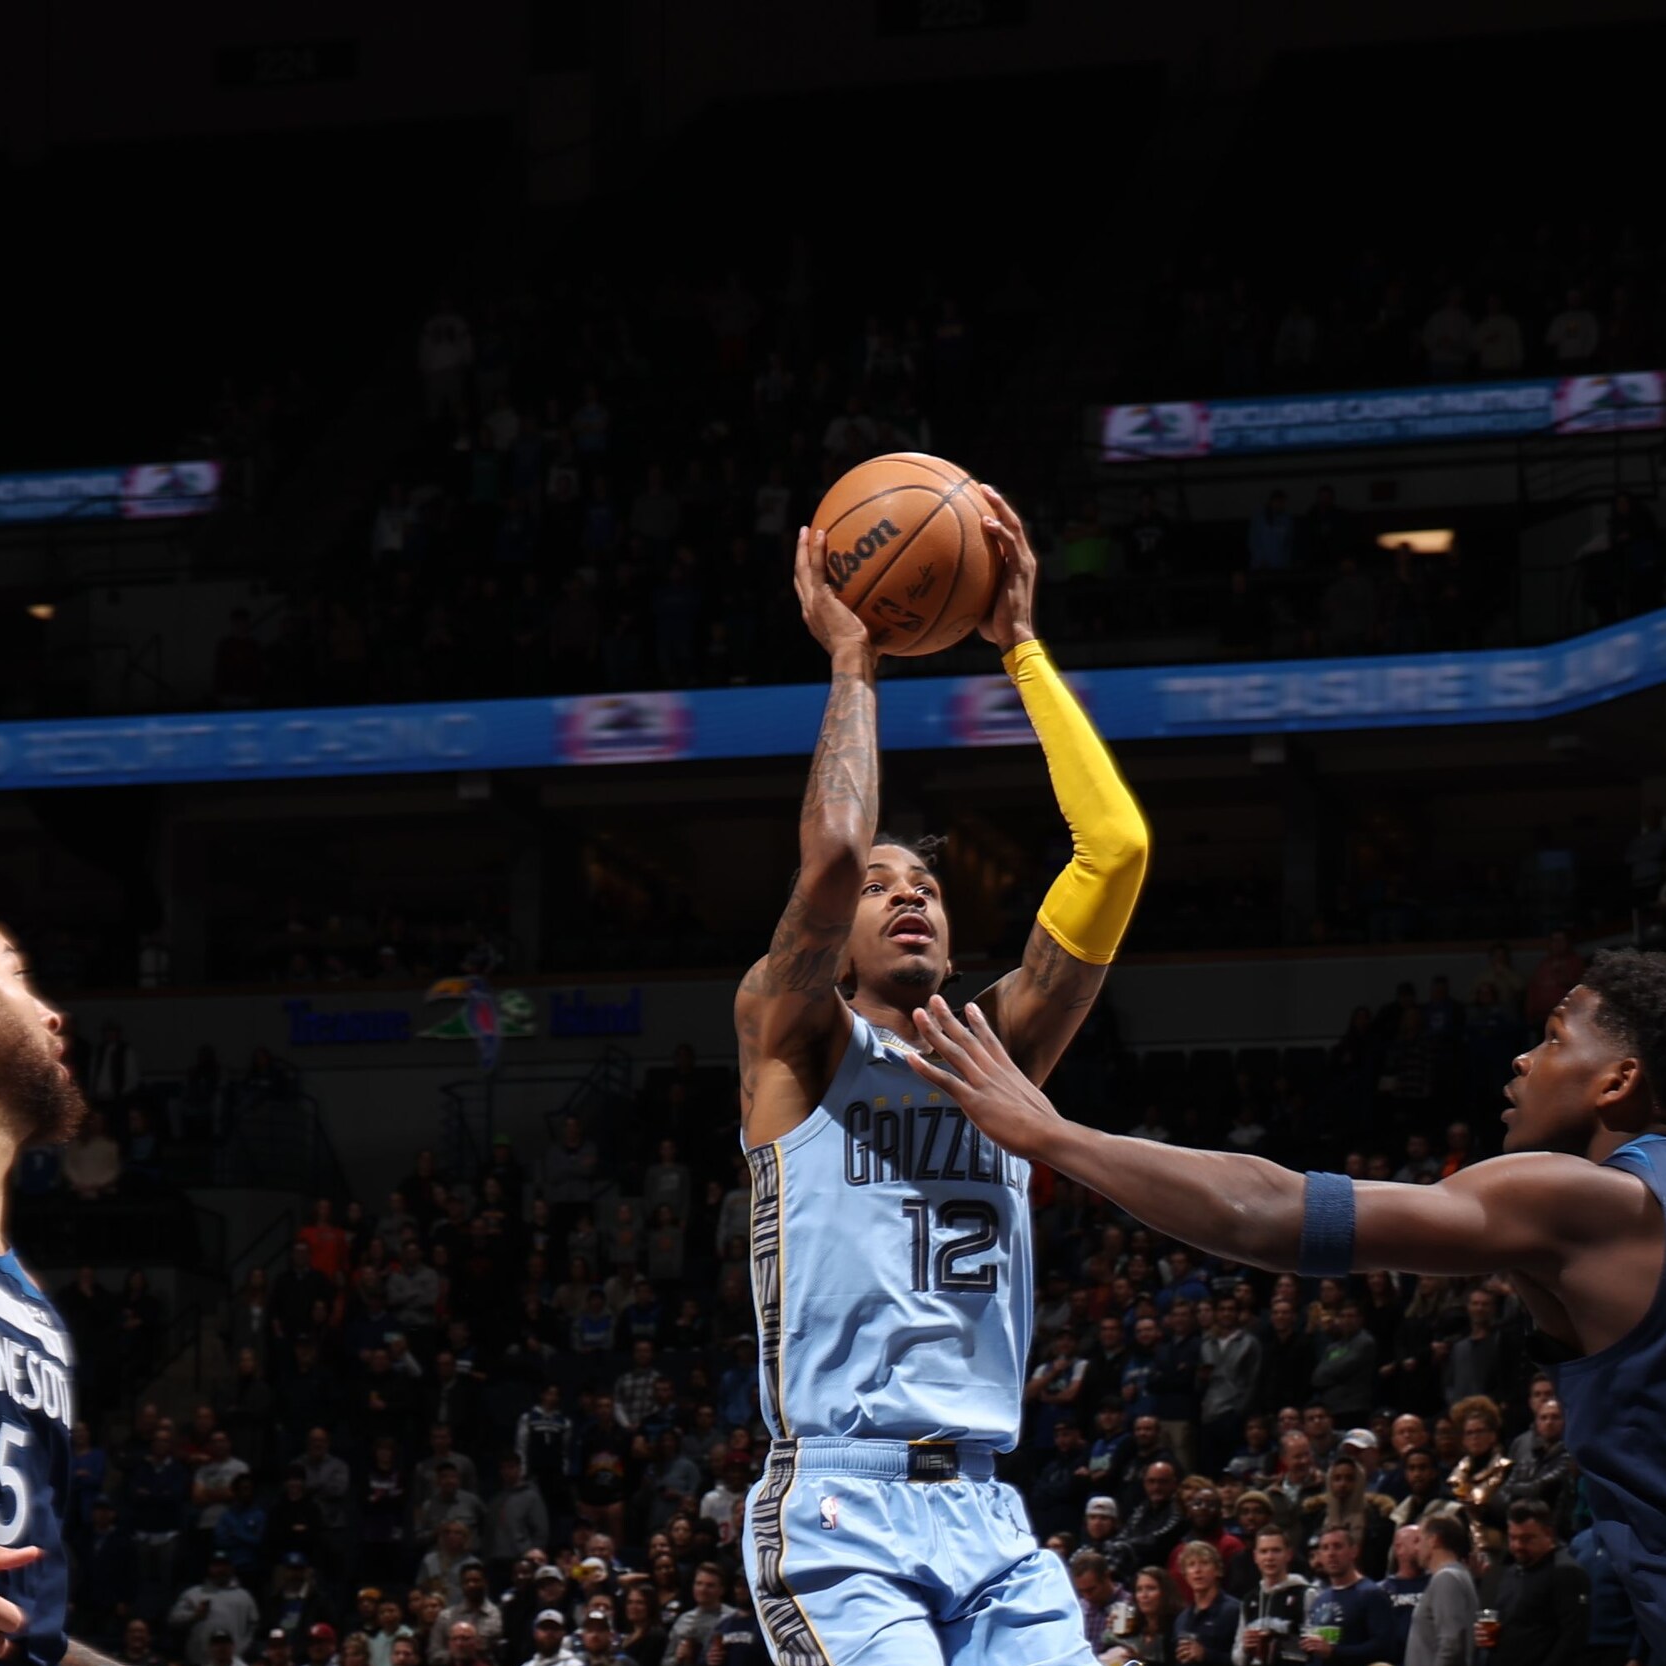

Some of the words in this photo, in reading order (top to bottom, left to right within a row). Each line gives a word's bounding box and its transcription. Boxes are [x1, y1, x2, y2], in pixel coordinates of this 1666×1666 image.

[827, 518, 901, 593] lson
[284, 998, 412, 1045] Treasure
[549, 987, 642, 1036] Island
[845, 1100, 1025, 1199] GRIZZL
[901, 1198, 998, 1293] 12
